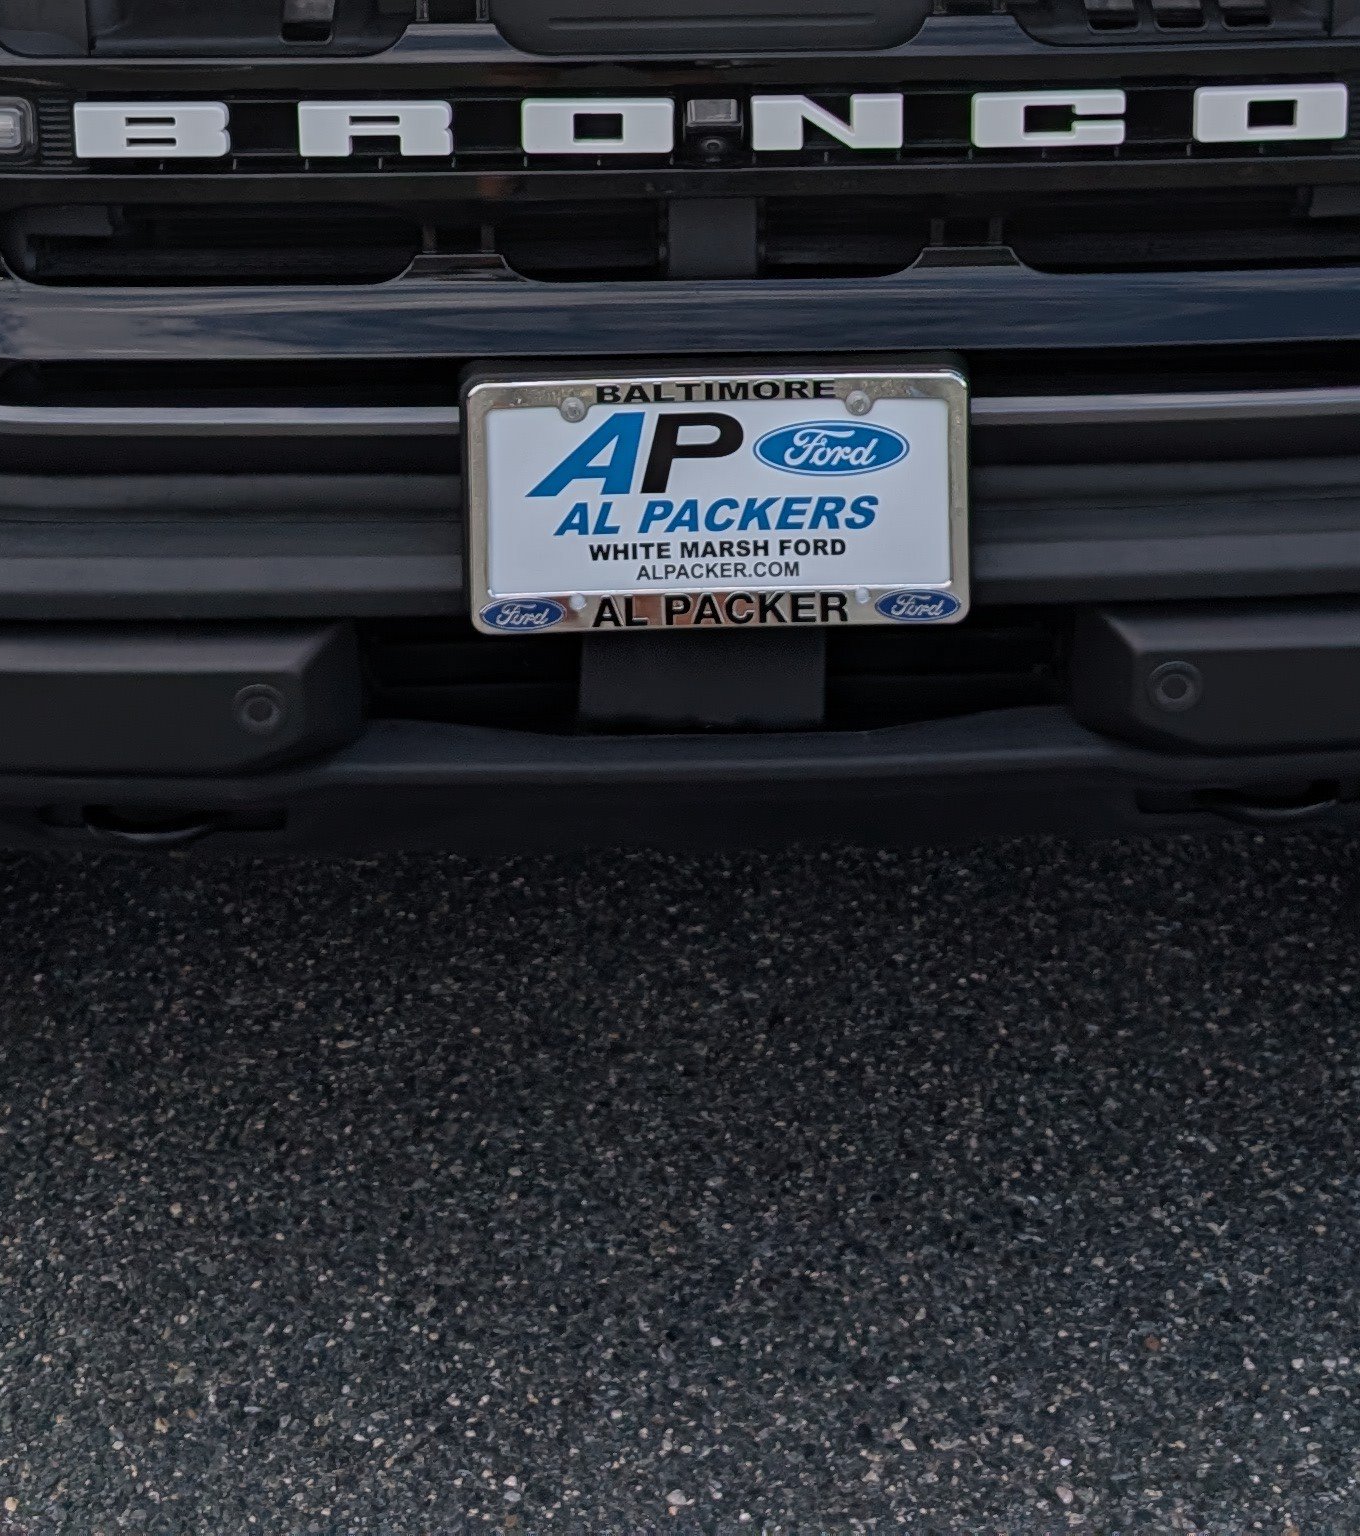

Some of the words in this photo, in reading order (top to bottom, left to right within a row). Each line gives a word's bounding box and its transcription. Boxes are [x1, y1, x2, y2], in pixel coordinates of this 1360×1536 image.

[73, 82, 1348, 159] BRONCO
[595, 380, 836, 404] BALTIMORE
[525, 411, 744, 497] AP
[783, 427, 880, 467] Ford
[553, 501, 620, 536] AL
[637, 495, 879, 534] PACKERS
[589, 542, 671, 561] WHITE
[680, 540, 769, 559] MARSH
[779, 538, 846, 556] FORD
[636, 561, 800, 581] ALPACKER.COM
[592, 594, 649, 628] AL
[664, 590, 849, 625] PACKER
